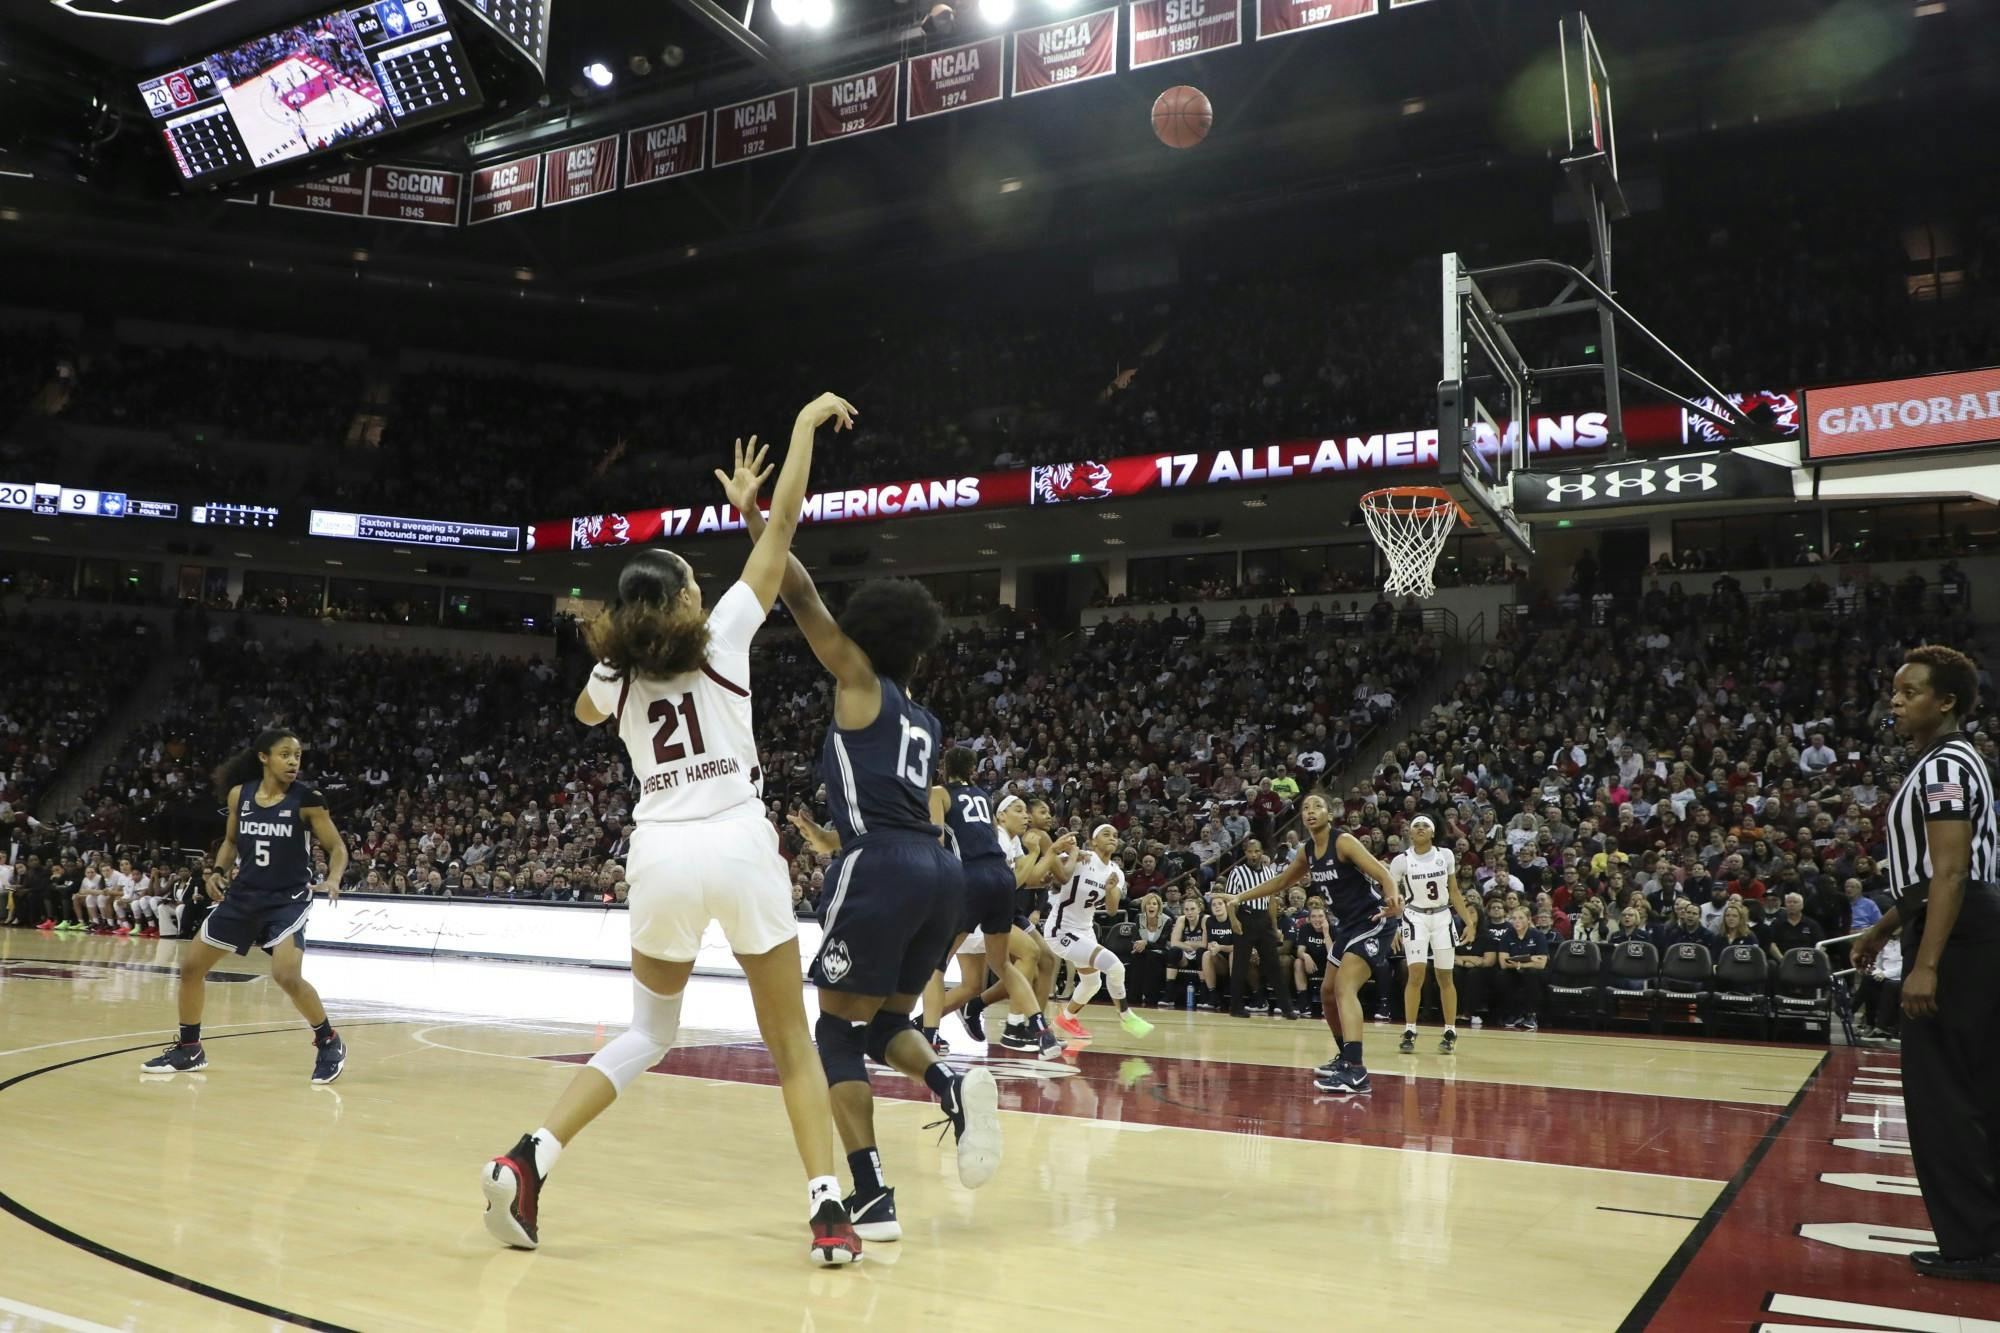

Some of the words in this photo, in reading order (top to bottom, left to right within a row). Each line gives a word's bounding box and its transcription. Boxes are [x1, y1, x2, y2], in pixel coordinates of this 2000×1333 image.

[416, 1, 428, 17] 9
[1166, 0, 1206, 24] SEC
[1301, 4, 1332, 25] 1997
[358, 19, 378, 34] 6:30
[1198, 10, 1235, 28] CHAMPION
[509, 22, 516, 34] 0
[524, 34, 529, 46] 0
[1039, 22, 1091, 55] NCAA
[424, 49, 430, 58] 0
[441, 44, 448, 52] 0
[1170, 35, 1199, 54] 1997
[428, 60, 435, 68] 0
[446, 54, 452, 63] 0
[930, 49, 980, 81] NCAA
[1043, 48, 1085, 65] TOURNAMENT
[194, 75, 210, 88] 6:30
[400, 81, 406, 89] 0
[433, 71, 440, 80] 0
[450, 66, 456, 74] 0
[454, 76, 461, 85] 0
[935, 73, 974, 90] TOURNAMENT
[1050, 66, 1078, 82] 1989
[150, 89, 167, 106] 20
[408, 102, 416, 110] 0
[426, 97, 432, 106] 0
[442, 92, 448, 100] 0
[460, 87, 466, 96] 0
[832, 76, 878, 107] NCAA
[941, 90, 967, 108] 1974
[734, 100, 777, 130] NCAA
[182, 136, 188, 144] 0
[222, 124, 228, 132] 0
[841, 118, 865, 132] 1973
[646, 123, 687, 152] NCAA
[204, 152, 210, 160] 0
[218, 148, 224, 156] 0
[232, 144, 238, 152] 0
[743, 139, 765, 155] 1972
[566, 147, 597, 172] ACC
[491, 166, 520, 190] ACC
[654, 163, 675, 177] 1971
[386, 171, 444, 195] SoCON
[570, 182, 589, 196] 1971
[305, 194, 332, 208] 1934
[493, 200, 512, 213] 1970
[399, 205, 425, 219] 1945
[1155, 454, 1199, 488] 17
[0, 487, 28, 505] 20
[73, 494, 86, 510] 9
[140, 502, 172, 510] TIMEOUTS
[660, 507, 693, 537] 17
[696, 477, 981, 534] ALL-MERICANS
[360, 517, 392, 528] Saxton
[392, 520, 400, 529] is
[402, 522, 446, 534] averaging
[447, 524, 461, 534] 5.7
[462, 527, 490, 539] points
[491, 530, 508, 538] and
[360, 528, 373, 536] 3.7
[374, 528, 416, 540] rebounds
[418, 534, 434, 543] per
[436, 535, 460, 544] game
[647, 691, 706, 765] 21
[896, 713, 932, 789] 13
[685, 757, 740, 783] HARRIGAN
[957, 794, 991, 824] 20
[239, 820, 293, 837] UCONN
[255, 840, 270, 867] 5
[1411, 873, 1426, 881] SOUTH
[1320, 885, 1334, 906] 3
[1426, 880, 1439, 900] 3
